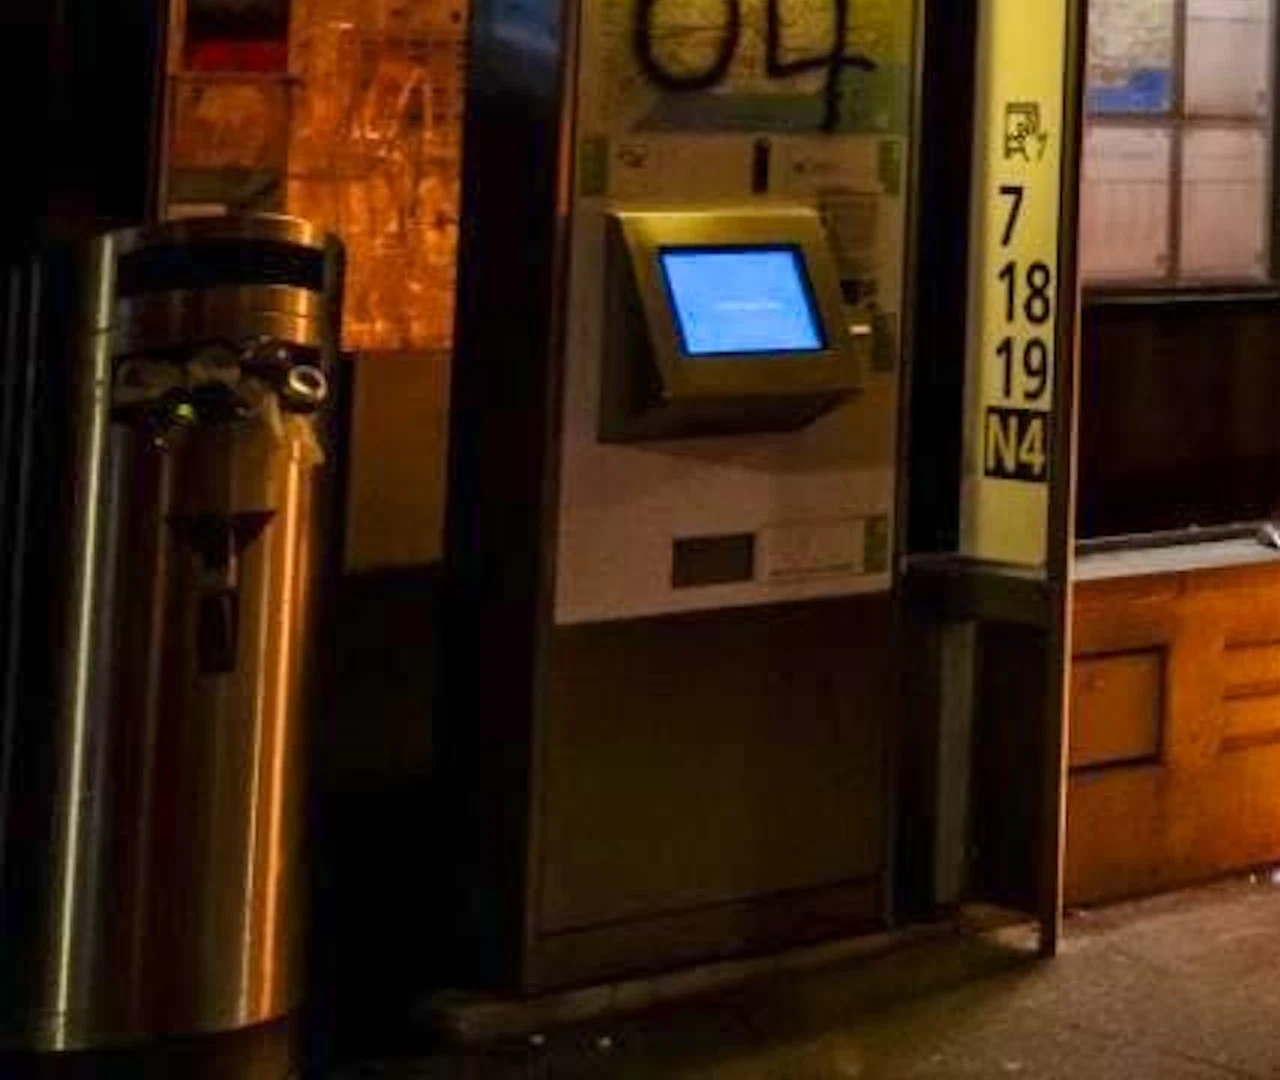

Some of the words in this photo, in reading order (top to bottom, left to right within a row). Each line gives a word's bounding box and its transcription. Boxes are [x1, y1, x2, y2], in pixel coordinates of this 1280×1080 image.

[998, 185, 1024, 247] 7
[997, 260, 1051, 325] 18
[996, 336, 1048, 401] 19
[986, 412, 1047, 477] N4
